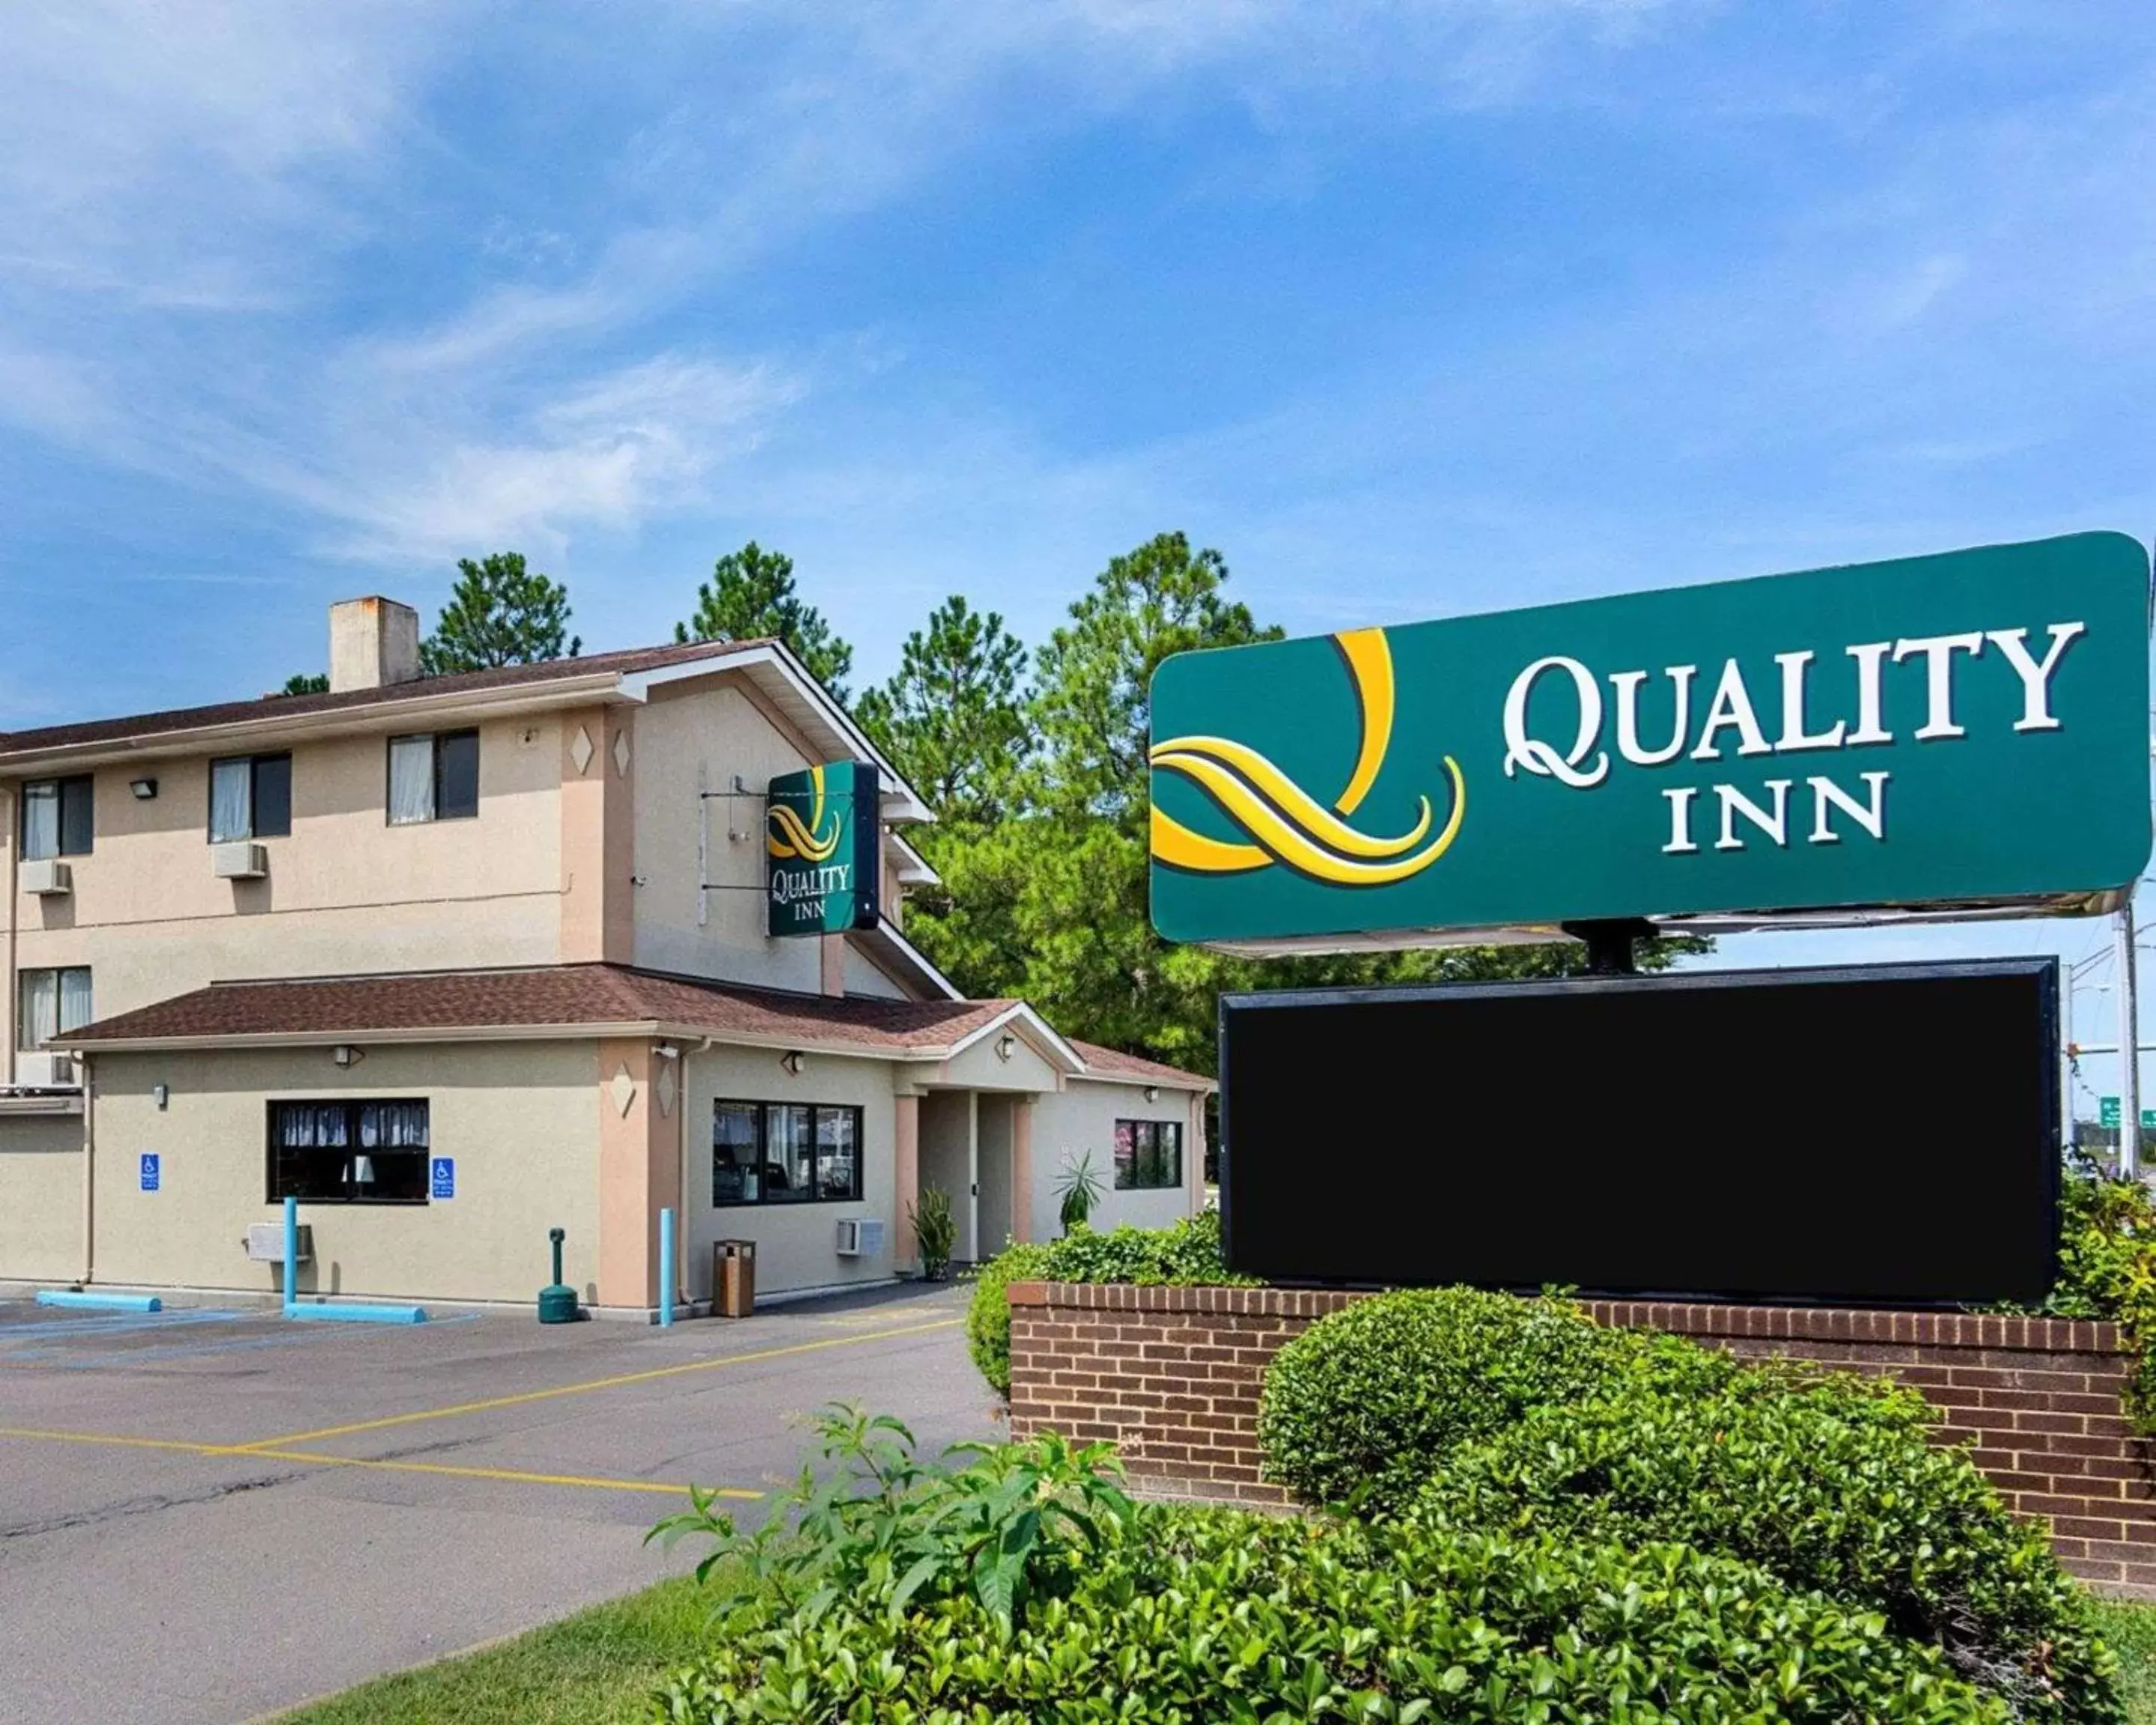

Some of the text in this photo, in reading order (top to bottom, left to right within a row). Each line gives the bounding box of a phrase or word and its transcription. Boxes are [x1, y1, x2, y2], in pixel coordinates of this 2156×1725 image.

[1503, 621, 2084, 788] QUALITY
[1662, 771, 1889, 852] INN
[773, 864, 850, 904] QUALITY
[794, 900, 826, 920] INN
